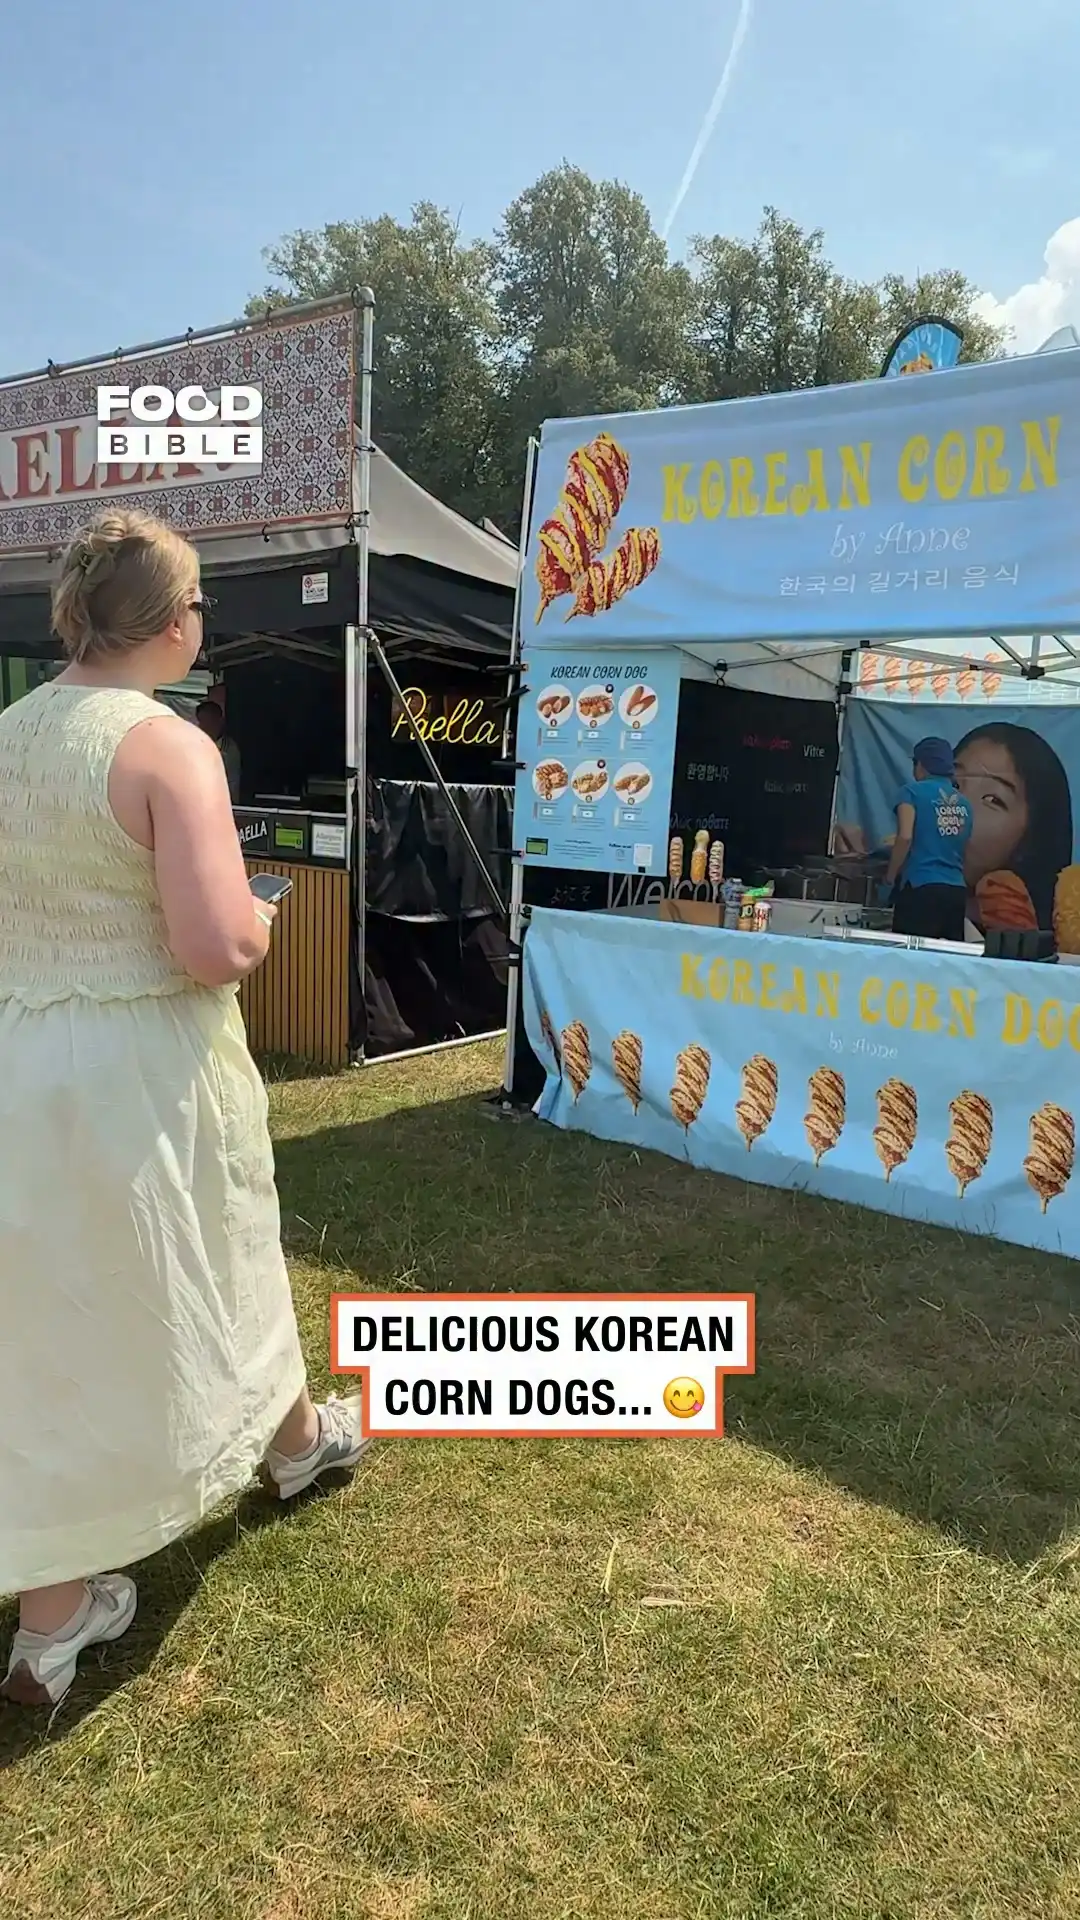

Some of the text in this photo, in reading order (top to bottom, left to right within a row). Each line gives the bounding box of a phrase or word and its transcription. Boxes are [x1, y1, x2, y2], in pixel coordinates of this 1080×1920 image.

[661, 416, 1061, 523] KOREAN CORN
[831, 522, 971, 563] by Anne
[780, 563, 1020, 596] 한국의 길거리 음식
[550, 666, 648, 679] KOREAN CORN DOG
[391, 687, 501, 744] Paella
[680, 952, 841, 1020] KOREAN
[859, 976, 978, 1038] CORN
[828, 1032, 844, 1054] by
